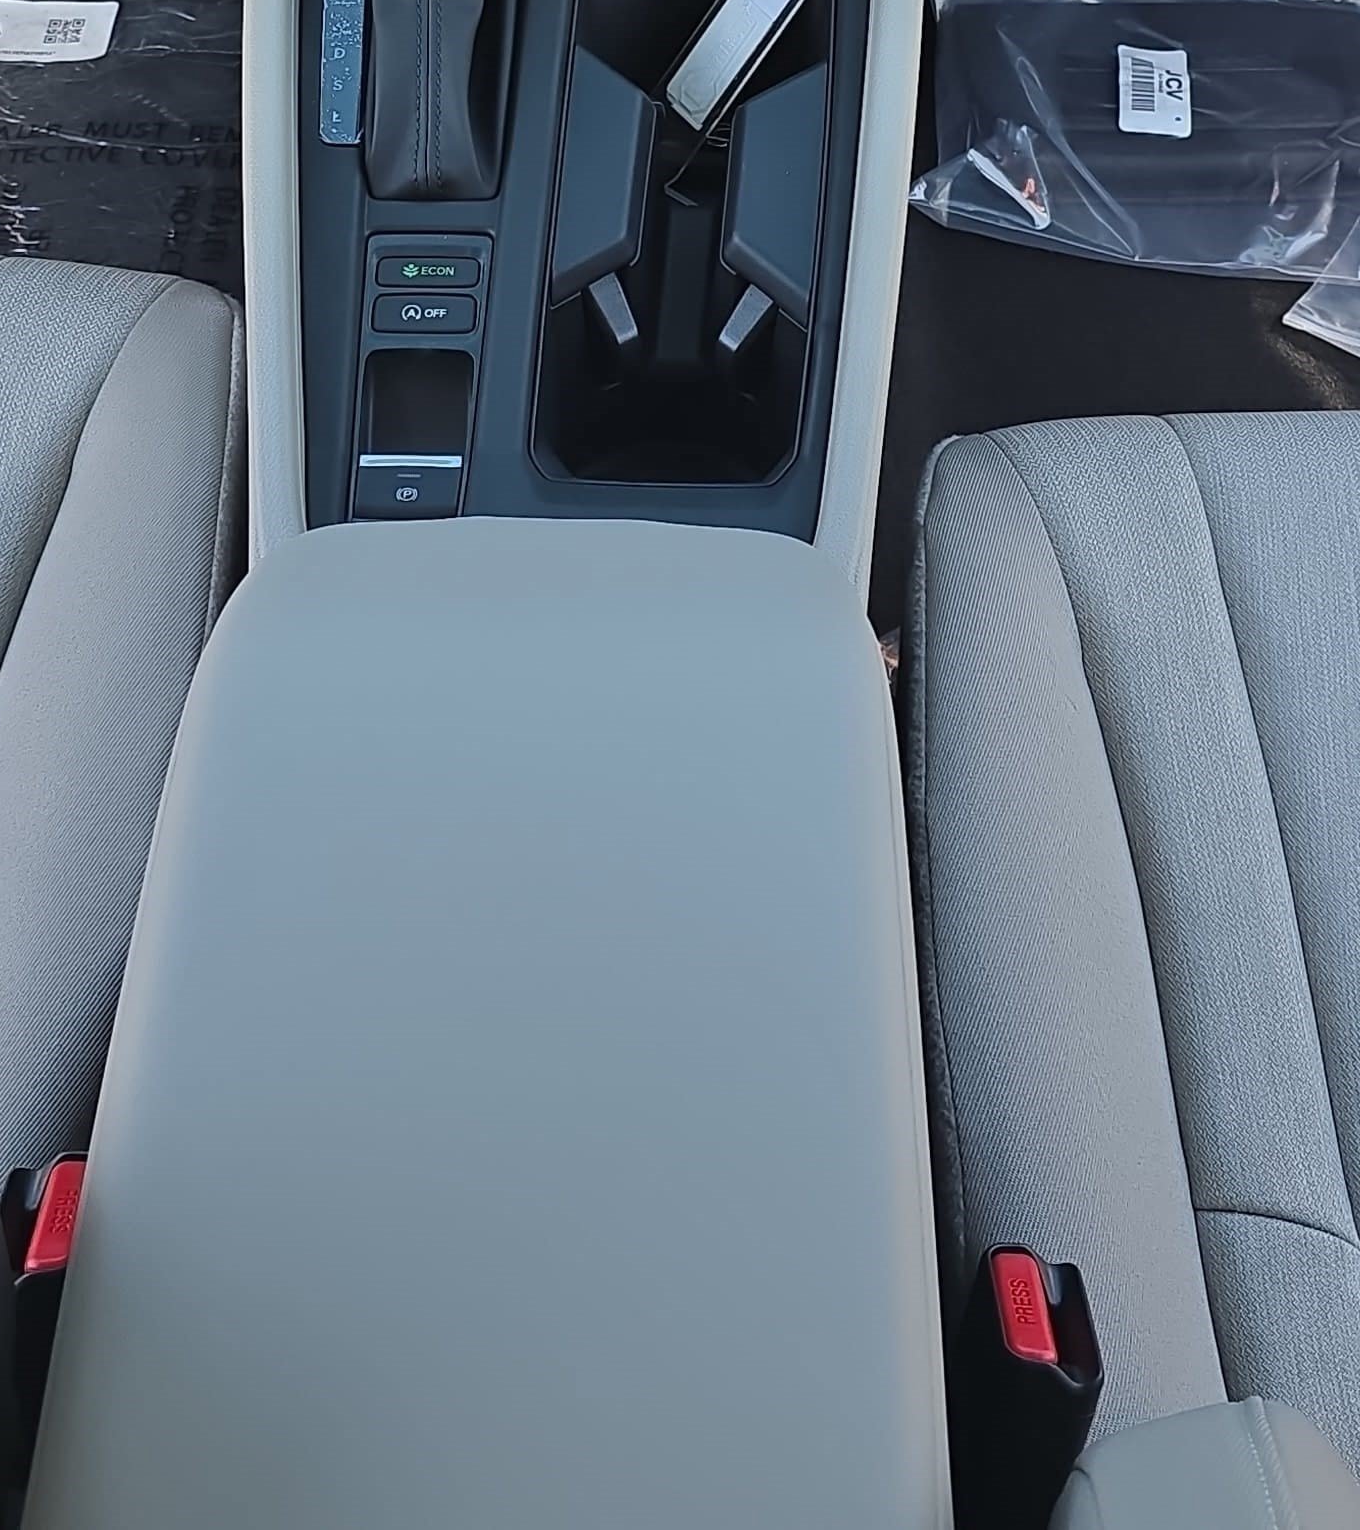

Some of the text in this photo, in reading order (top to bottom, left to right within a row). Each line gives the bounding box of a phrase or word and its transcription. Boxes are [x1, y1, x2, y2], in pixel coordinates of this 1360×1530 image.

[82, 122, 170, 140] MUST
[421, 265, 455, 276] ECON
[425, 308, 447, 318] OFF
[1008, 1277, 1036, 1325] PRESS
